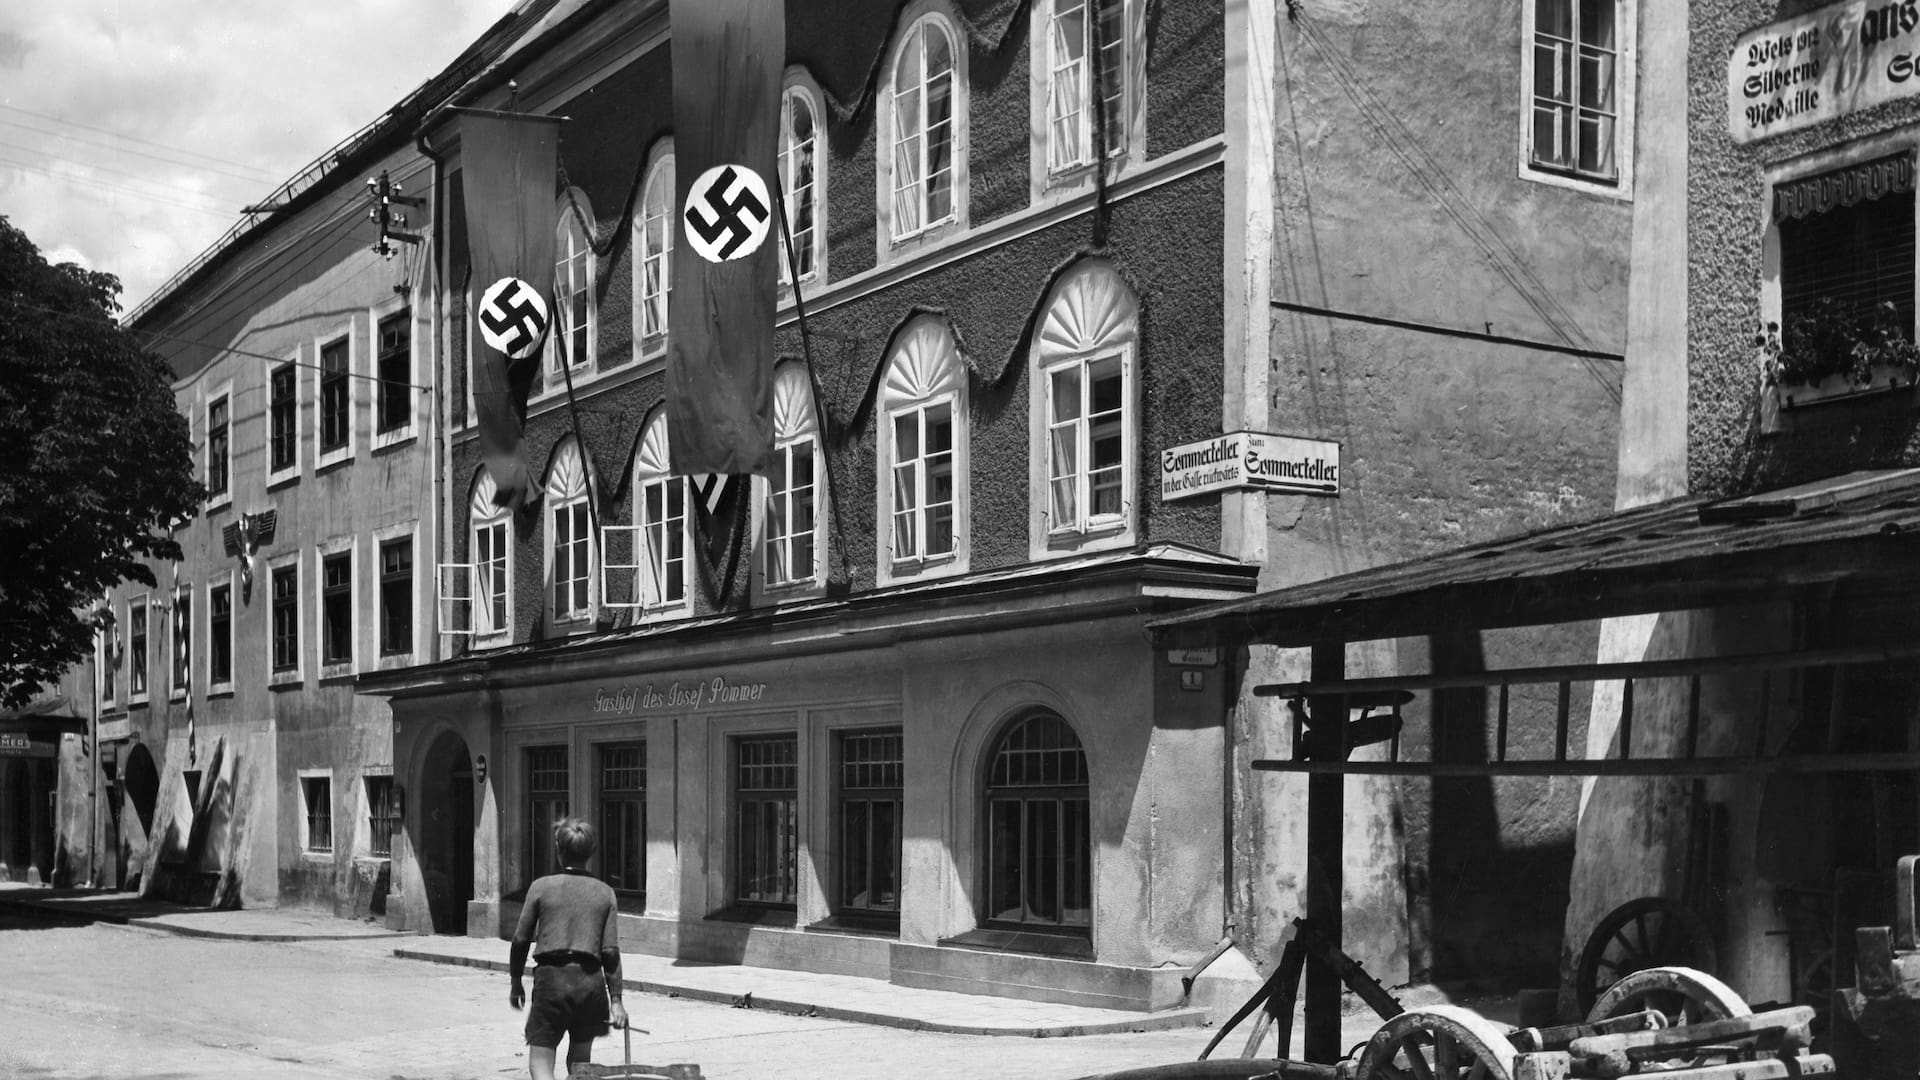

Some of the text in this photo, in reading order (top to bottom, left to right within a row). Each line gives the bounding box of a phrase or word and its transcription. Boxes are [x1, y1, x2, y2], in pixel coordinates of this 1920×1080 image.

[1743, 58, 1820, 98] Silberne
[1745, 90, 1820, 128] Medaille
[1163, 439, 1239, 473] Sommerkeller
[1244, 450, 1337, 481] Sommerkeller
[1171, 477, 1182, 492] der
[594, 680, 639, 714] Gasthof
[643, 683, 664, 709] des
[709, 676, 766, 704] Pommer
